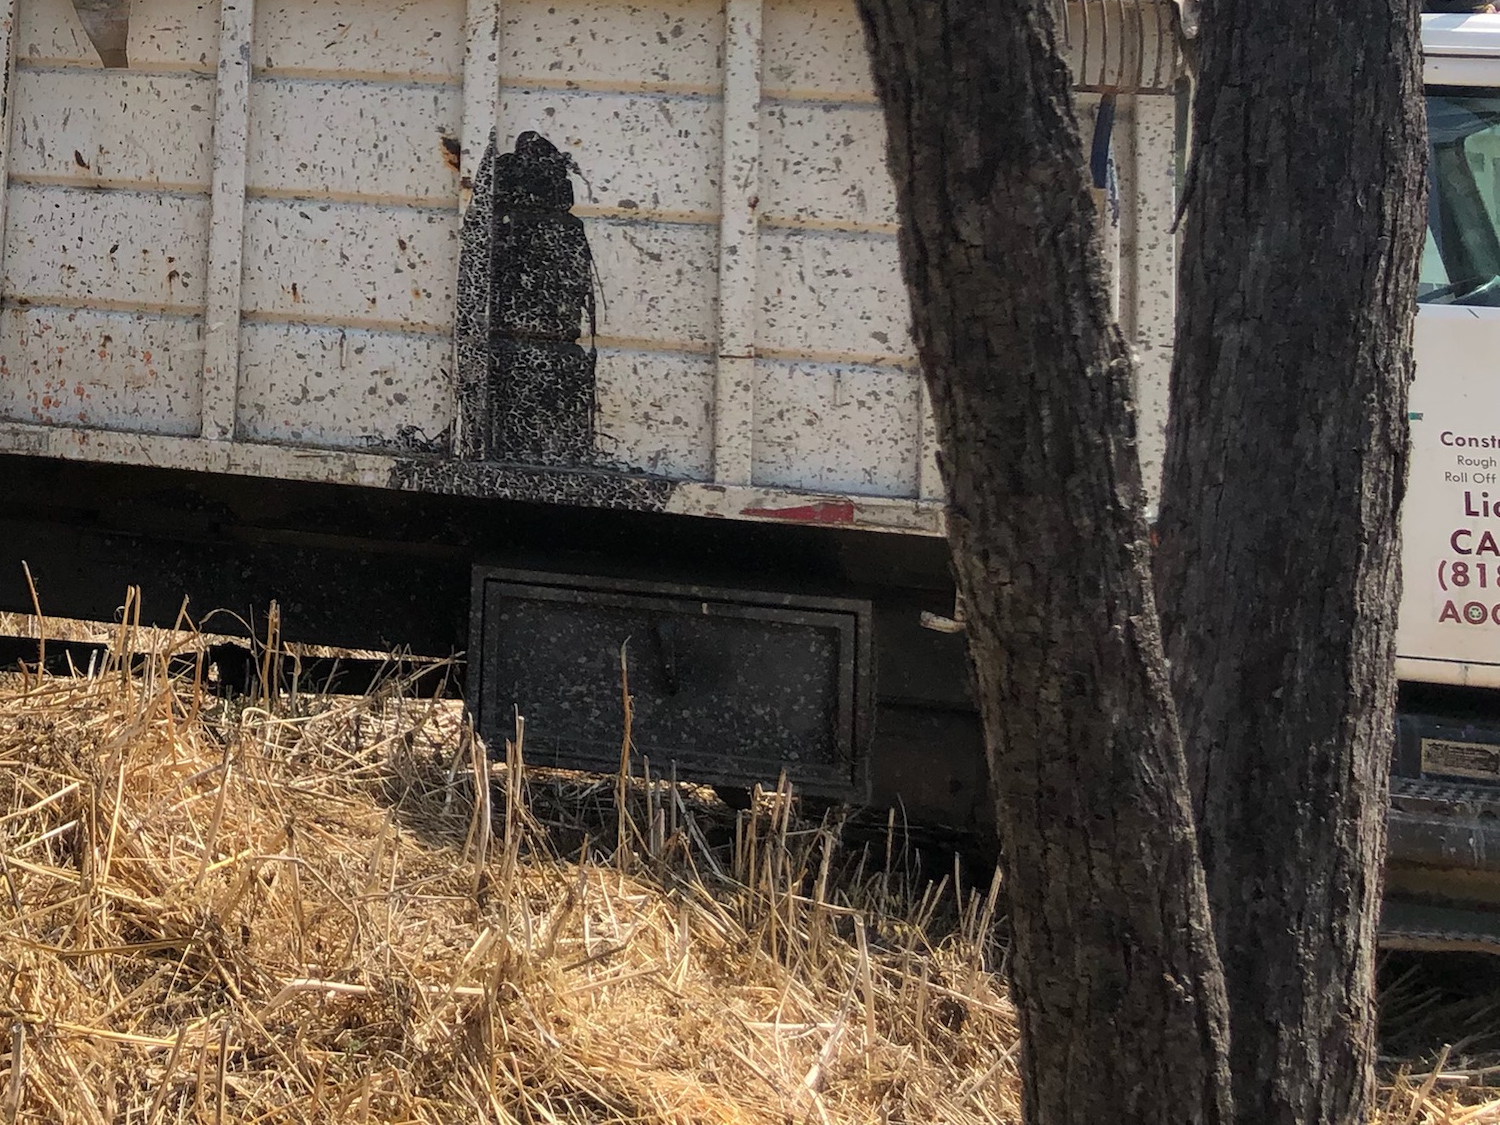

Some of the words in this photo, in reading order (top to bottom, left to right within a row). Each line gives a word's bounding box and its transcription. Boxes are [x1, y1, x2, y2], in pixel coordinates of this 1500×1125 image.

[1457, 455, 1497, 470] Rough
[1445, 472, 1468, 483] Roll
[1473, 472, 1497, 484] Off
[1450, 529, 1500, 556] CA
[1438, 560, 1500, 591] (81
